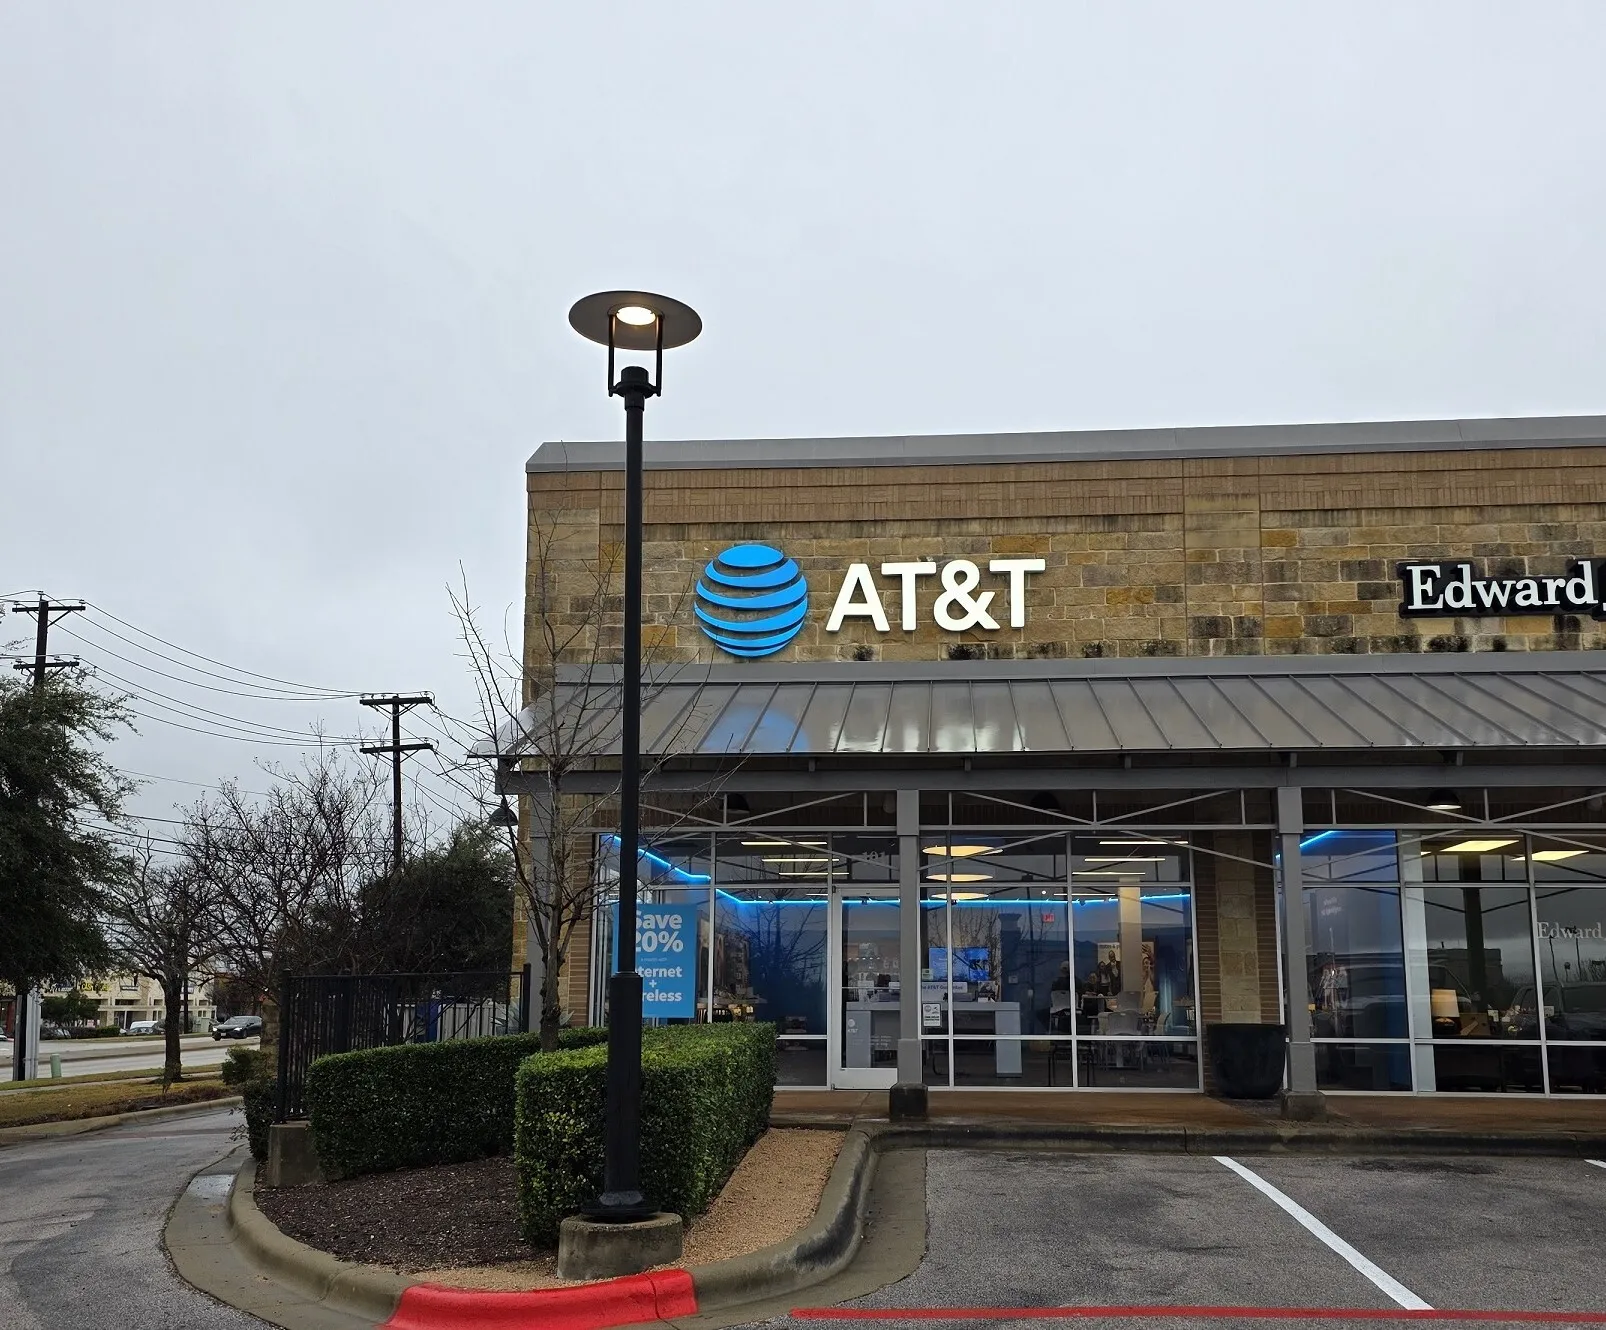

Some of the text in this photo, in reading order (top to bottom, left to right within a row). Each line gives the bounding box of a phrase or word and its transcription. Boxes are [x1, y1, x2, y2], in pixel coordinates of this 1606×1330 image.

[1406, 560, 1599, 610] Edward
[826, 558, 1046, 632] AT&T
[1537, 921, 1603, 939] Edward
[636, 966, 682, 977] ternet
[642, 989, 682, 1002] reless
